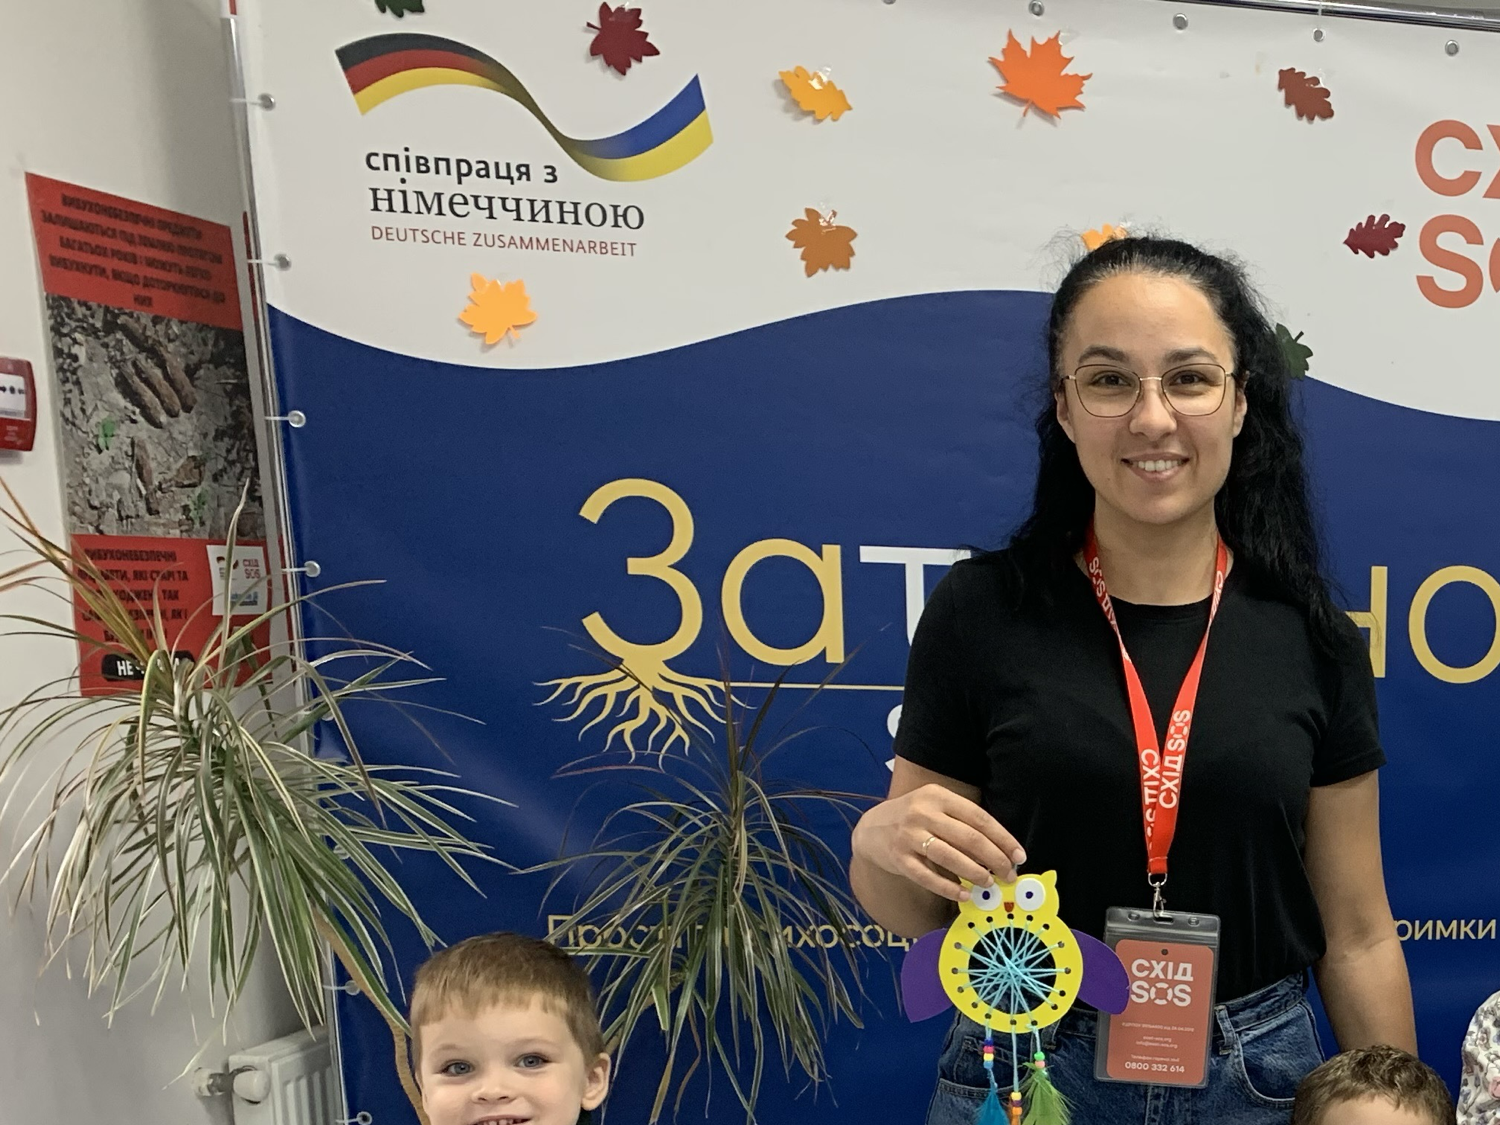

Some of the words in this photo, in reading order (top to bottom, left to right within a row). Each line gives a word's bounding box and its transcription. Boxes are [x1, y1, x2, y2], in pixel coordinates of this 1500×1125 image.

[365, 147, 531, 185] співпраця
[543, 164, 559, 183] з
[368, 178, 645, 230] німеччиною
[371, 226, 467, 246] DEUTSCHE
[472, 232, 637, 257] ZUSAMMENARBEIT
[1167, 709, 1191, 752] SOS
[1159, 754, 1183, 809] СХІД
[1131, 958, 1194, 981] СХІД
[1130, 980, 1192, 1007] SOS
[1124, 1061, 1149, 1071] 0800
[1150, 1063, 1168, 1072] 332
[1169, 1065, 1185, 1073] 614
